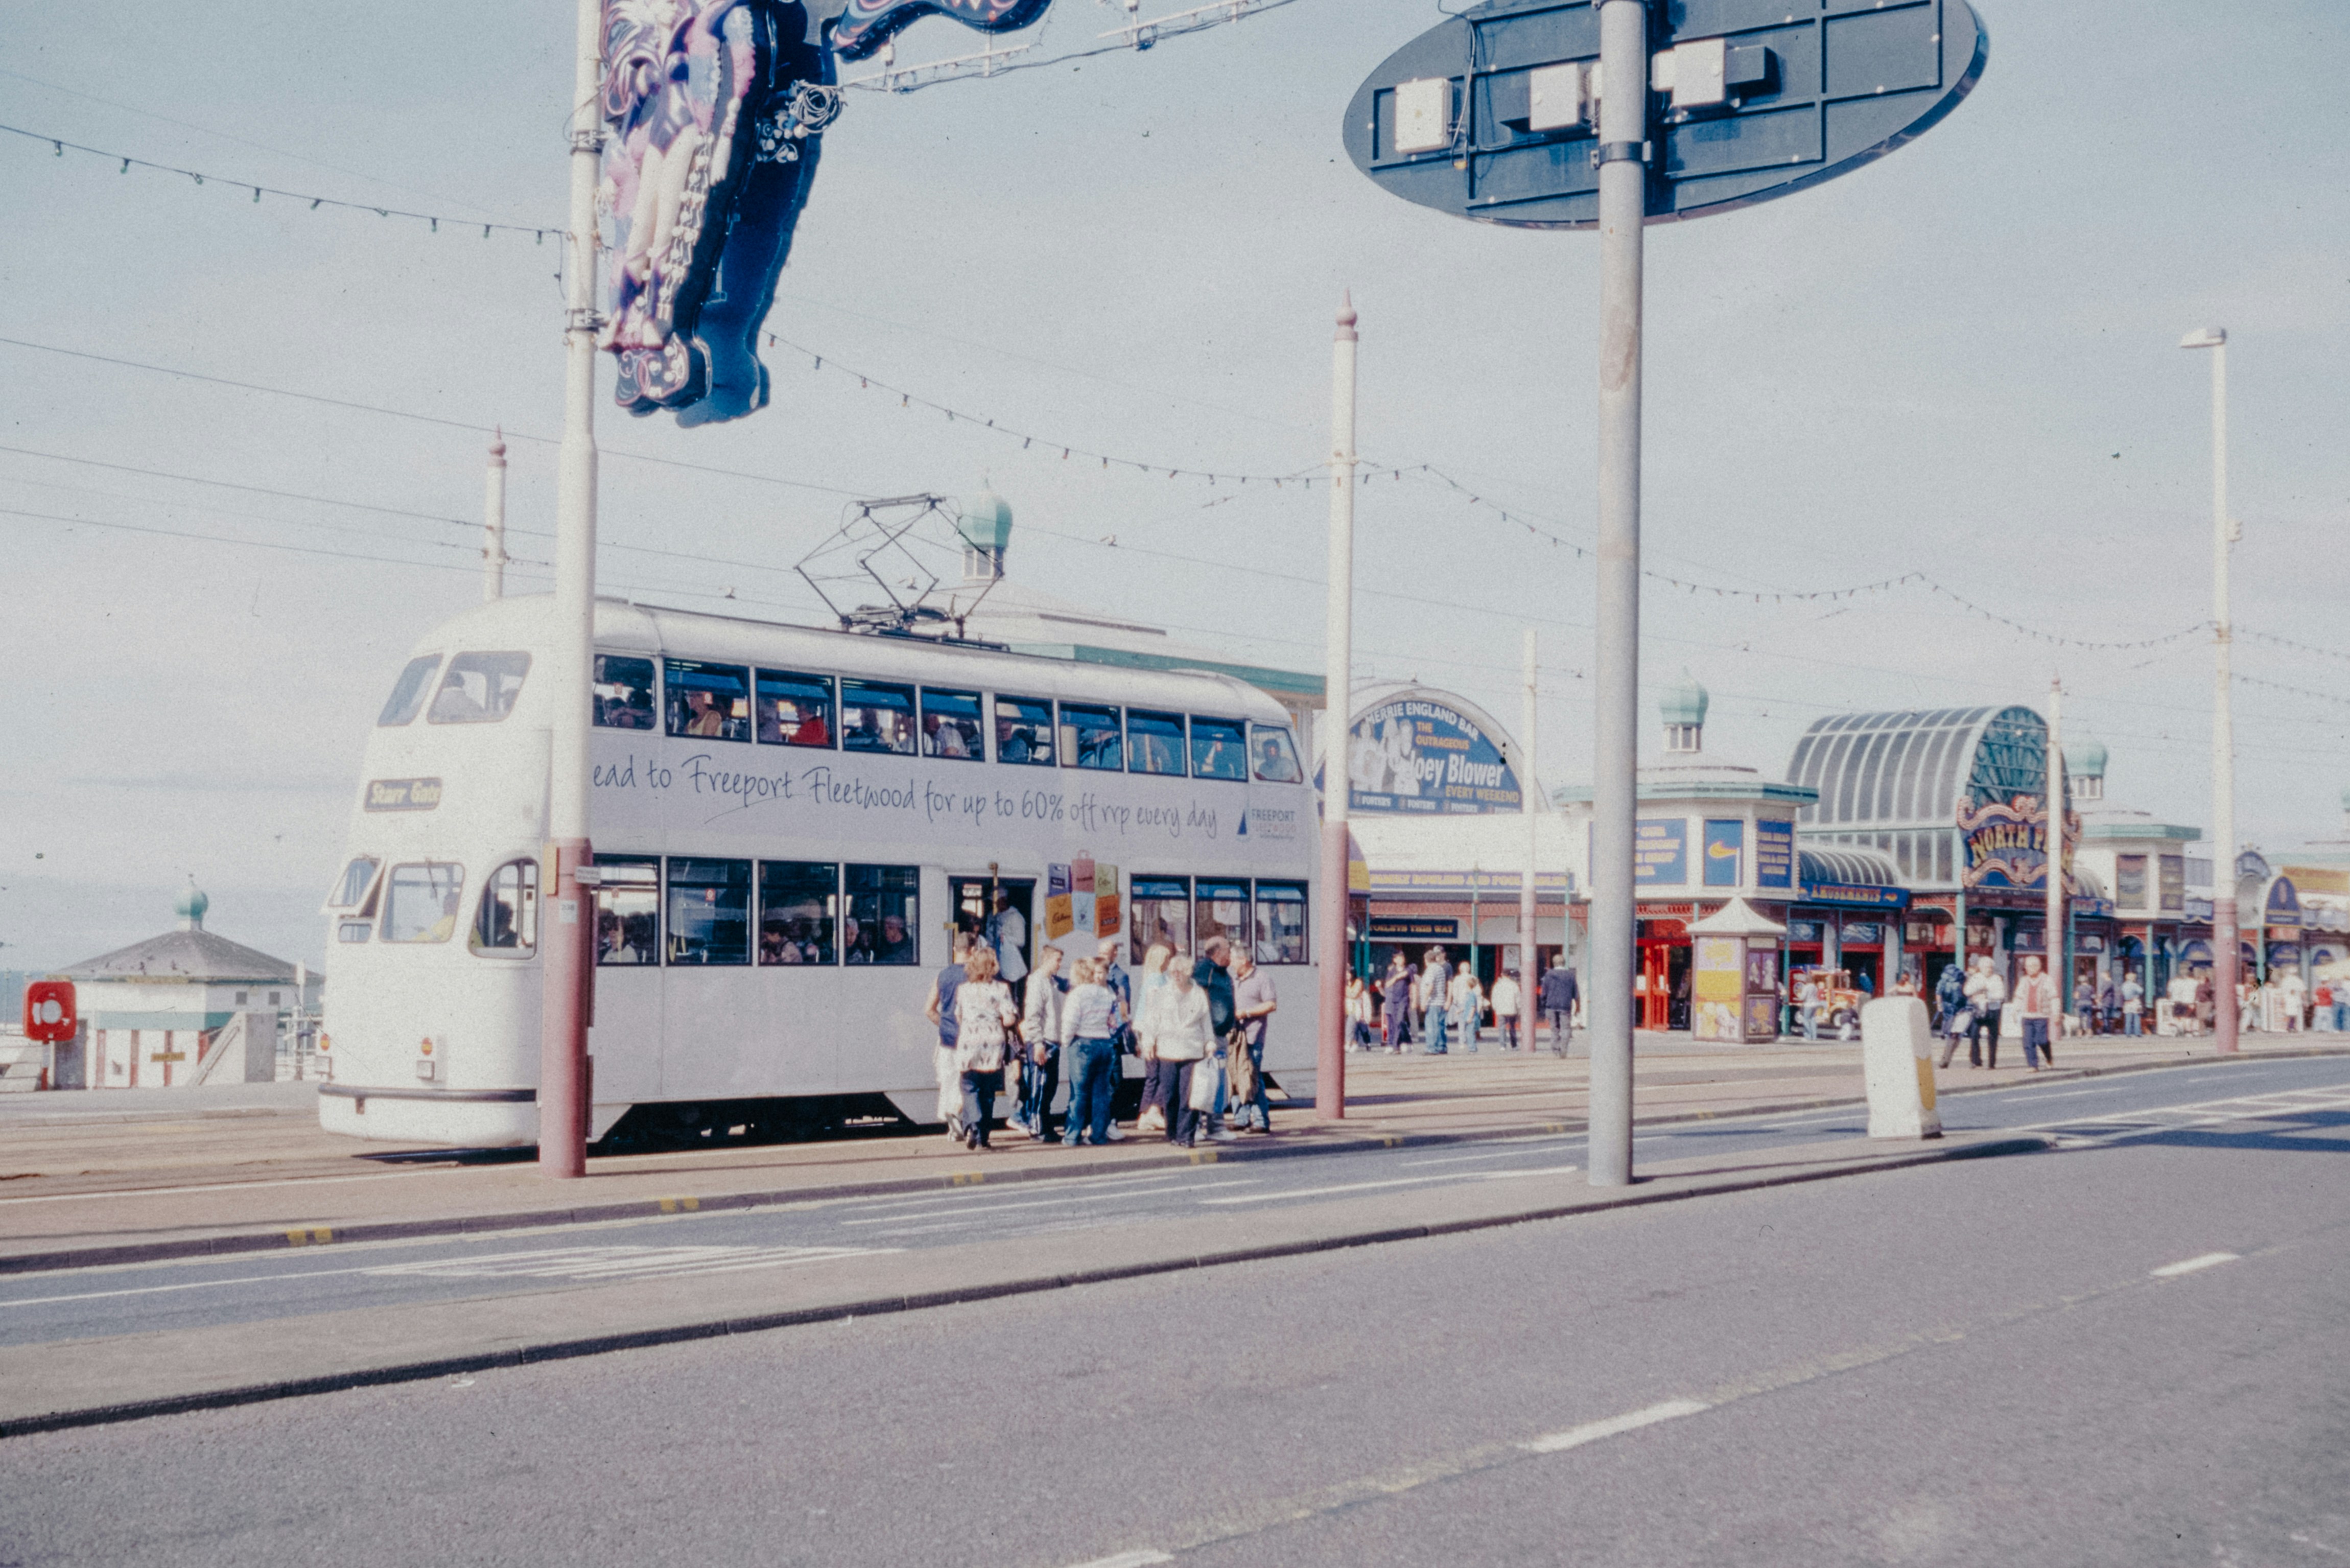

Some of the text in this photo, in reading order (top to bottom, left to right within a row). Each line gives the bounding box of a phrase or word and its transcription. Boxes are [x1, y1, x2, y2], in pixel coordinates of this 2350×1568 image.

[1366, 702, 1479, 741] MERRIE ENGLAND BAR
[1416, 721, 1470, 750] THE OUTRAGEOUS
[1409, 750, 1505, 788] Joey Blower
[593, 754, 1217, 839] ead to Freeport Fleetwood for up to 60% off rrp every day
[1445, 784, 1473, 799] EVERY
[1476, 788, 1519, 803] WEEKEND
[1252, 808, 1295, 822] FREEPORT
[1968, 823, 2075, 876] NORTH PIR
